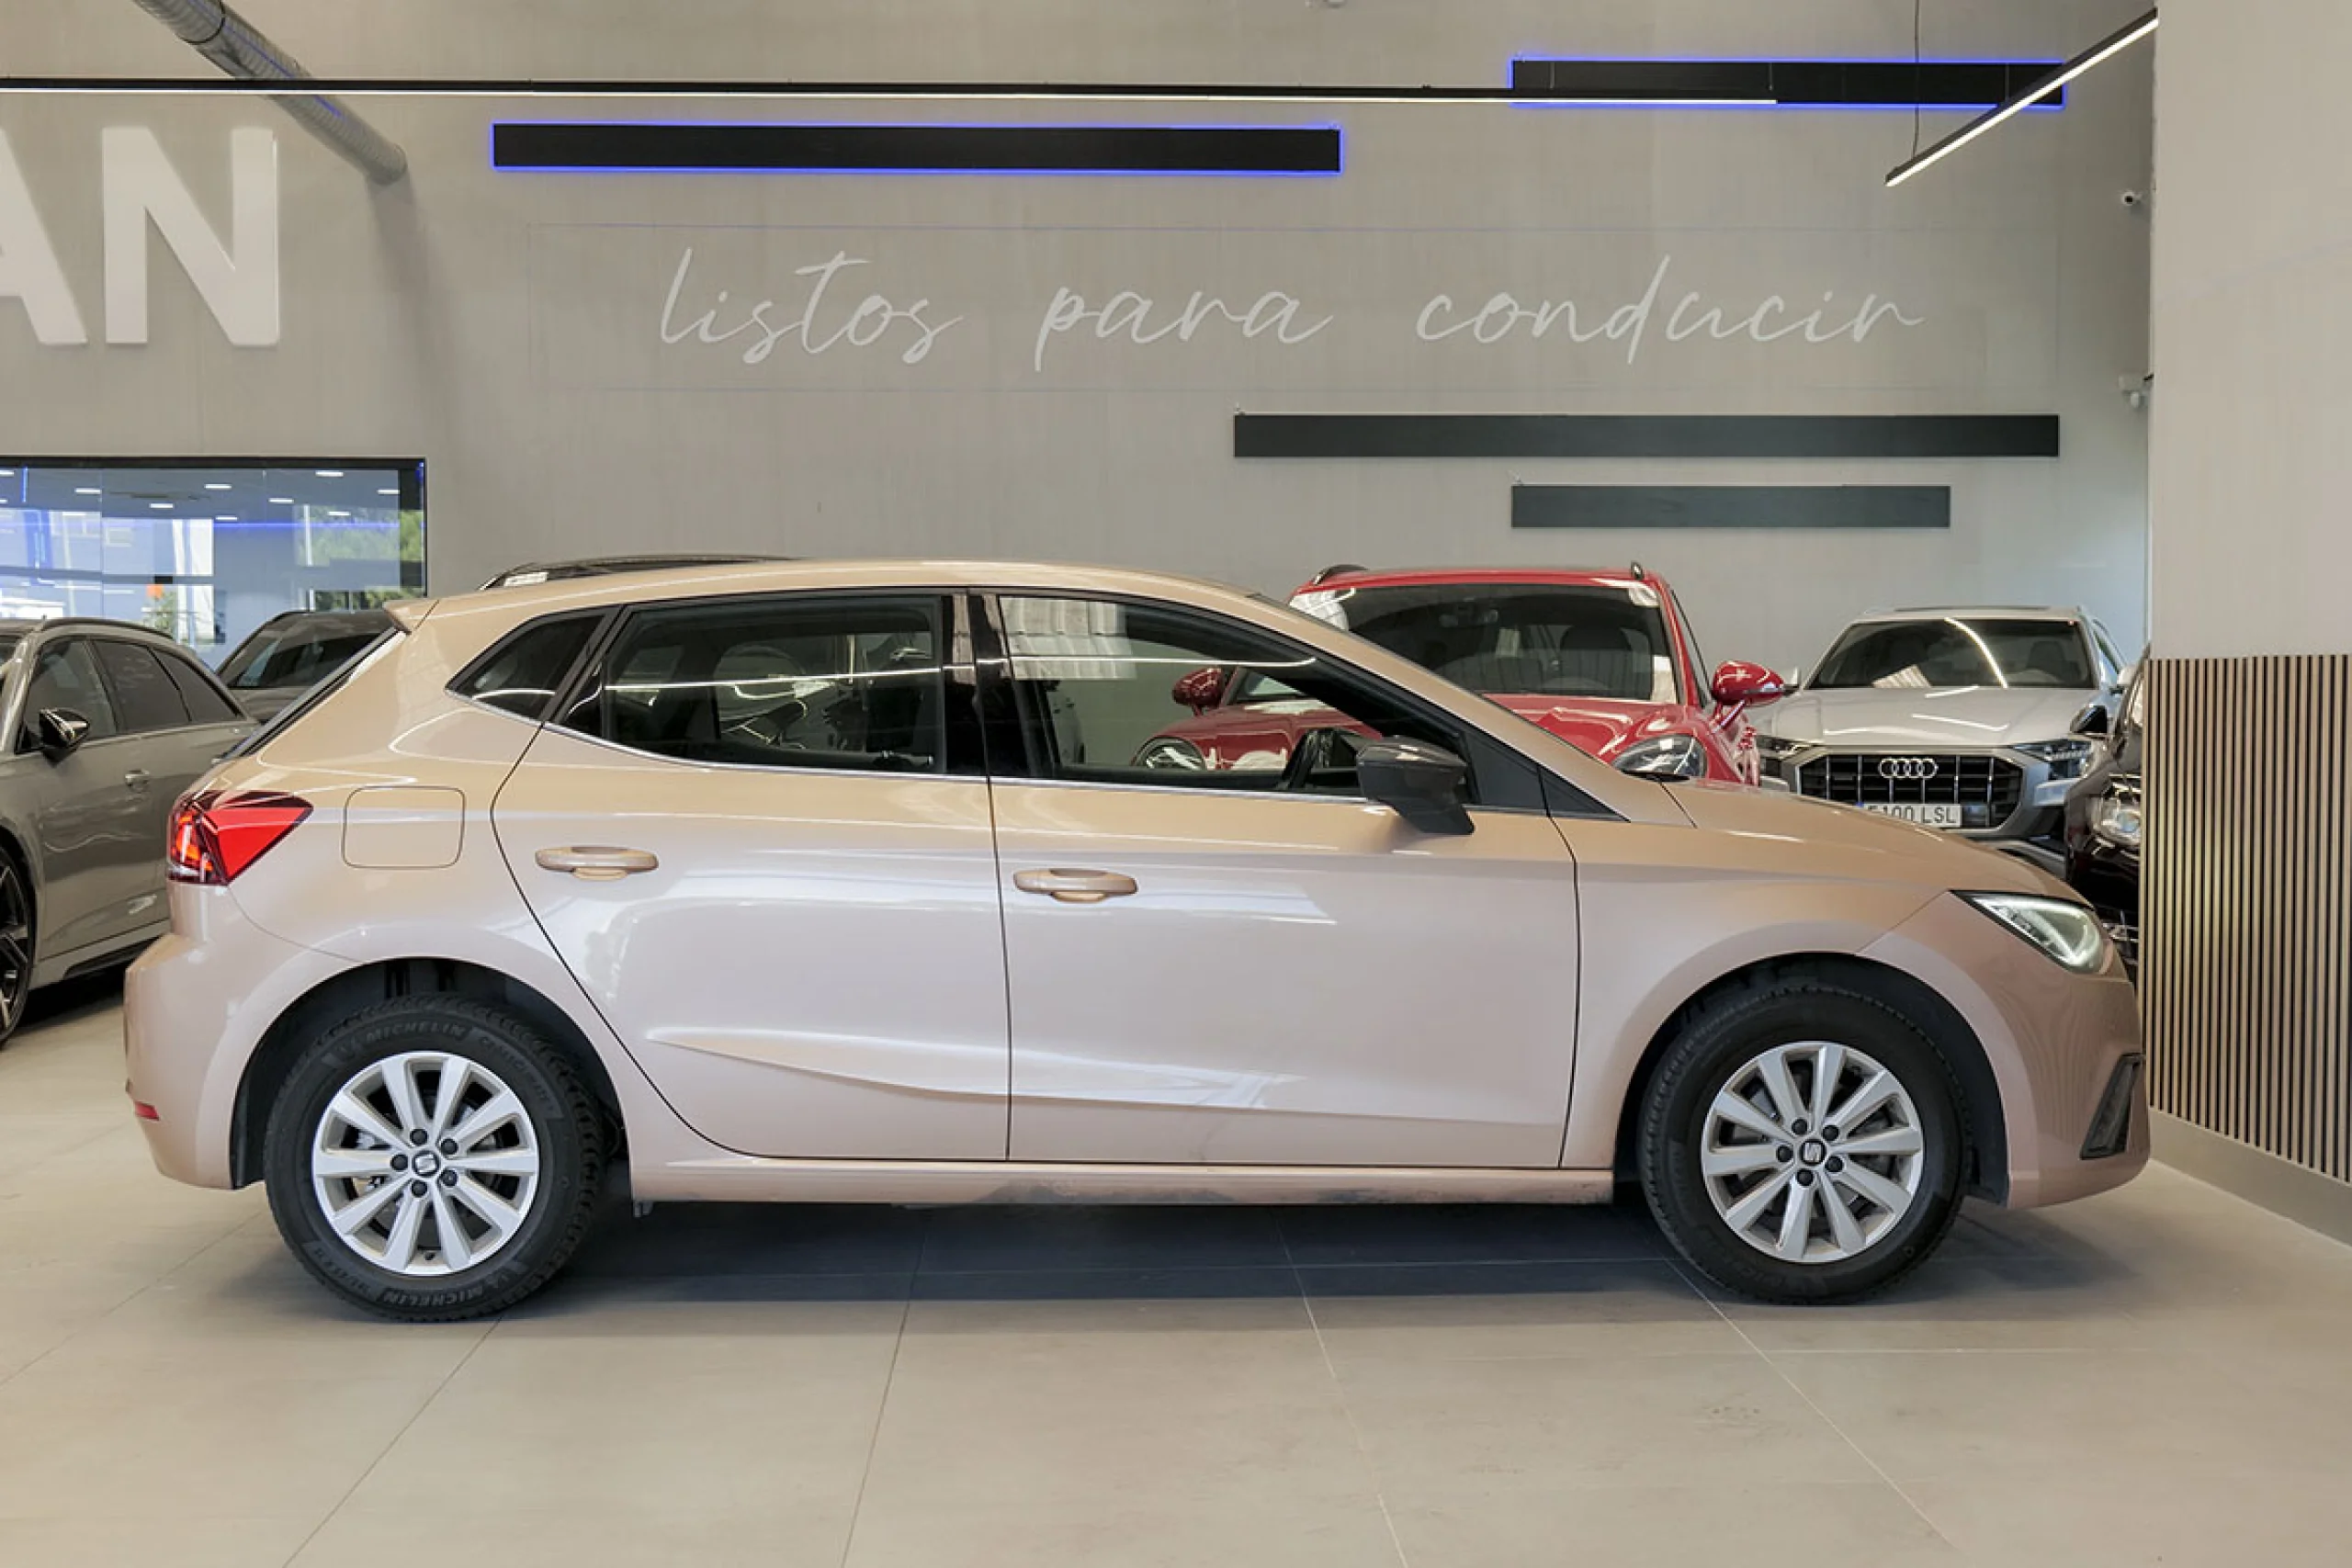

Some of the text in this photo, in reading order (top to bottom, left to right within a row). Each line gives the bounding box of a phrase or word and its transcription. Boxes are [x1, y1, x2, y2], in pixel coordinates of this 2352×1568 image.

[660, 246, 1924, 371] listos para conducir
[1867, 805, 1957, 823] 100 LSL
